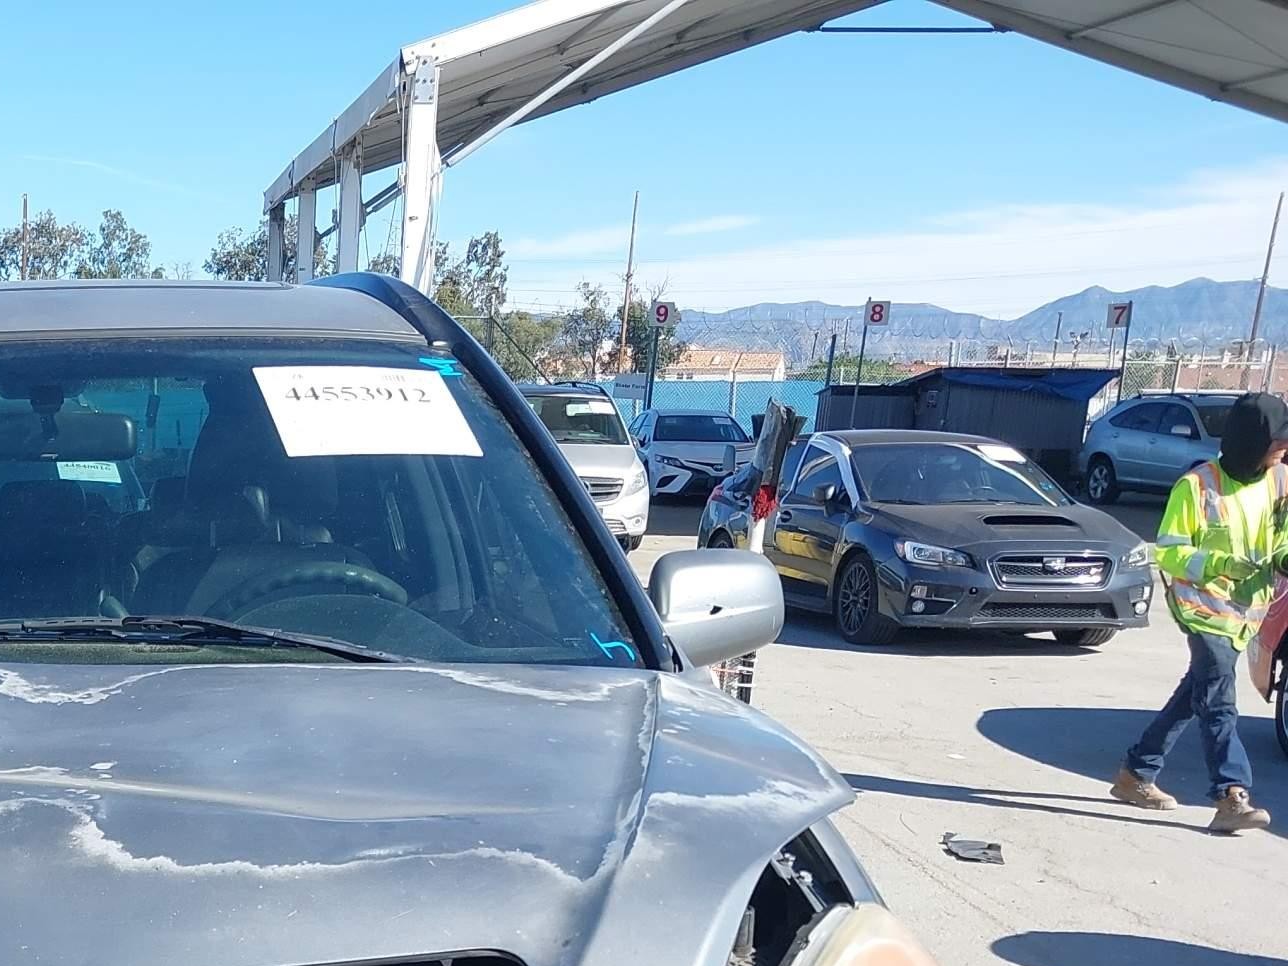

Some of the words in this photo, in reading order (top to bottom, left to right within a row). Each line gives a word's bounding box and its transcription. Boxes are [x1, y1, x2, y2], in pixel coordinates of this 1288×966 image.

[656, 305, 668, 323] 9
[870, 304, 884, 322] 8
[1114, 305, 1127, 324] 7
[284, 386, 431, 402] 44553912
